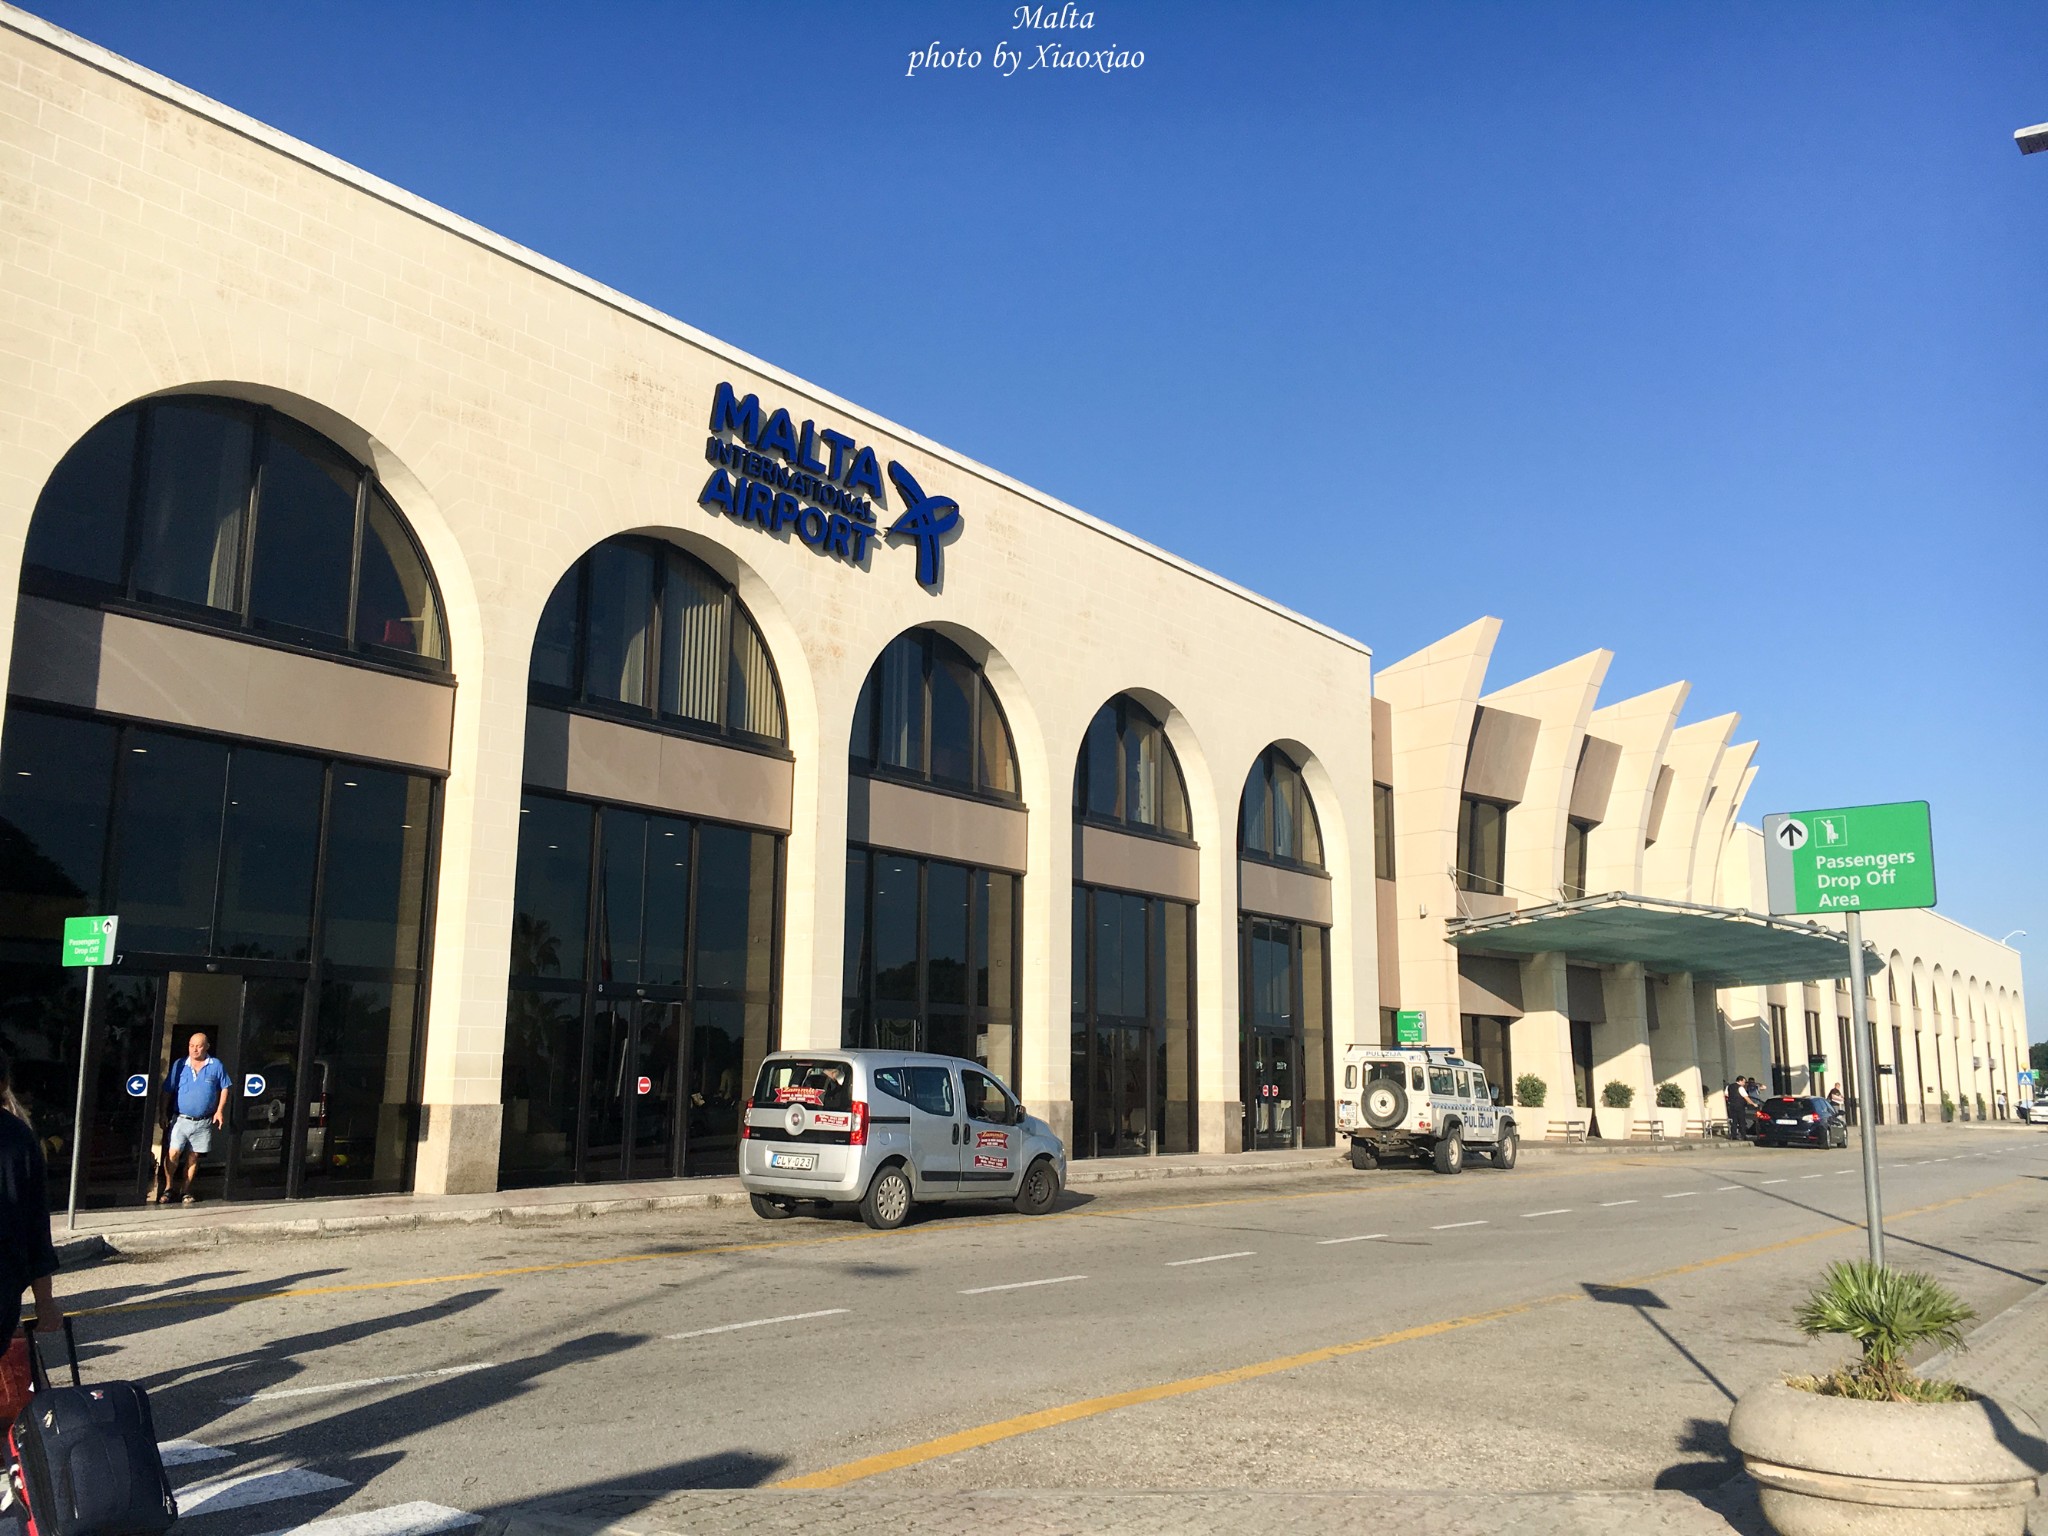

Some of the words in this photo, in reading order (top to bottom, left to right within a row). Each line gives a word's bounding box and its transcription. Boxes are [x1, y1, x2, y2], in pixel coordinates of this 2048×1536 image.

[709, 381, 883, 499] MALTA
[705, 436, 877, 524] INTERNATIONAL
[697, 468, 877, 562] AIRPORT
[1815, 851, 1916, 870] Passengers
[1817, 874, 1861, 890] Drop
[1866, 869, 1897, 886] Off
[1818, 893, 1860, 908] Area
[116, 954, 124, 965] 7
